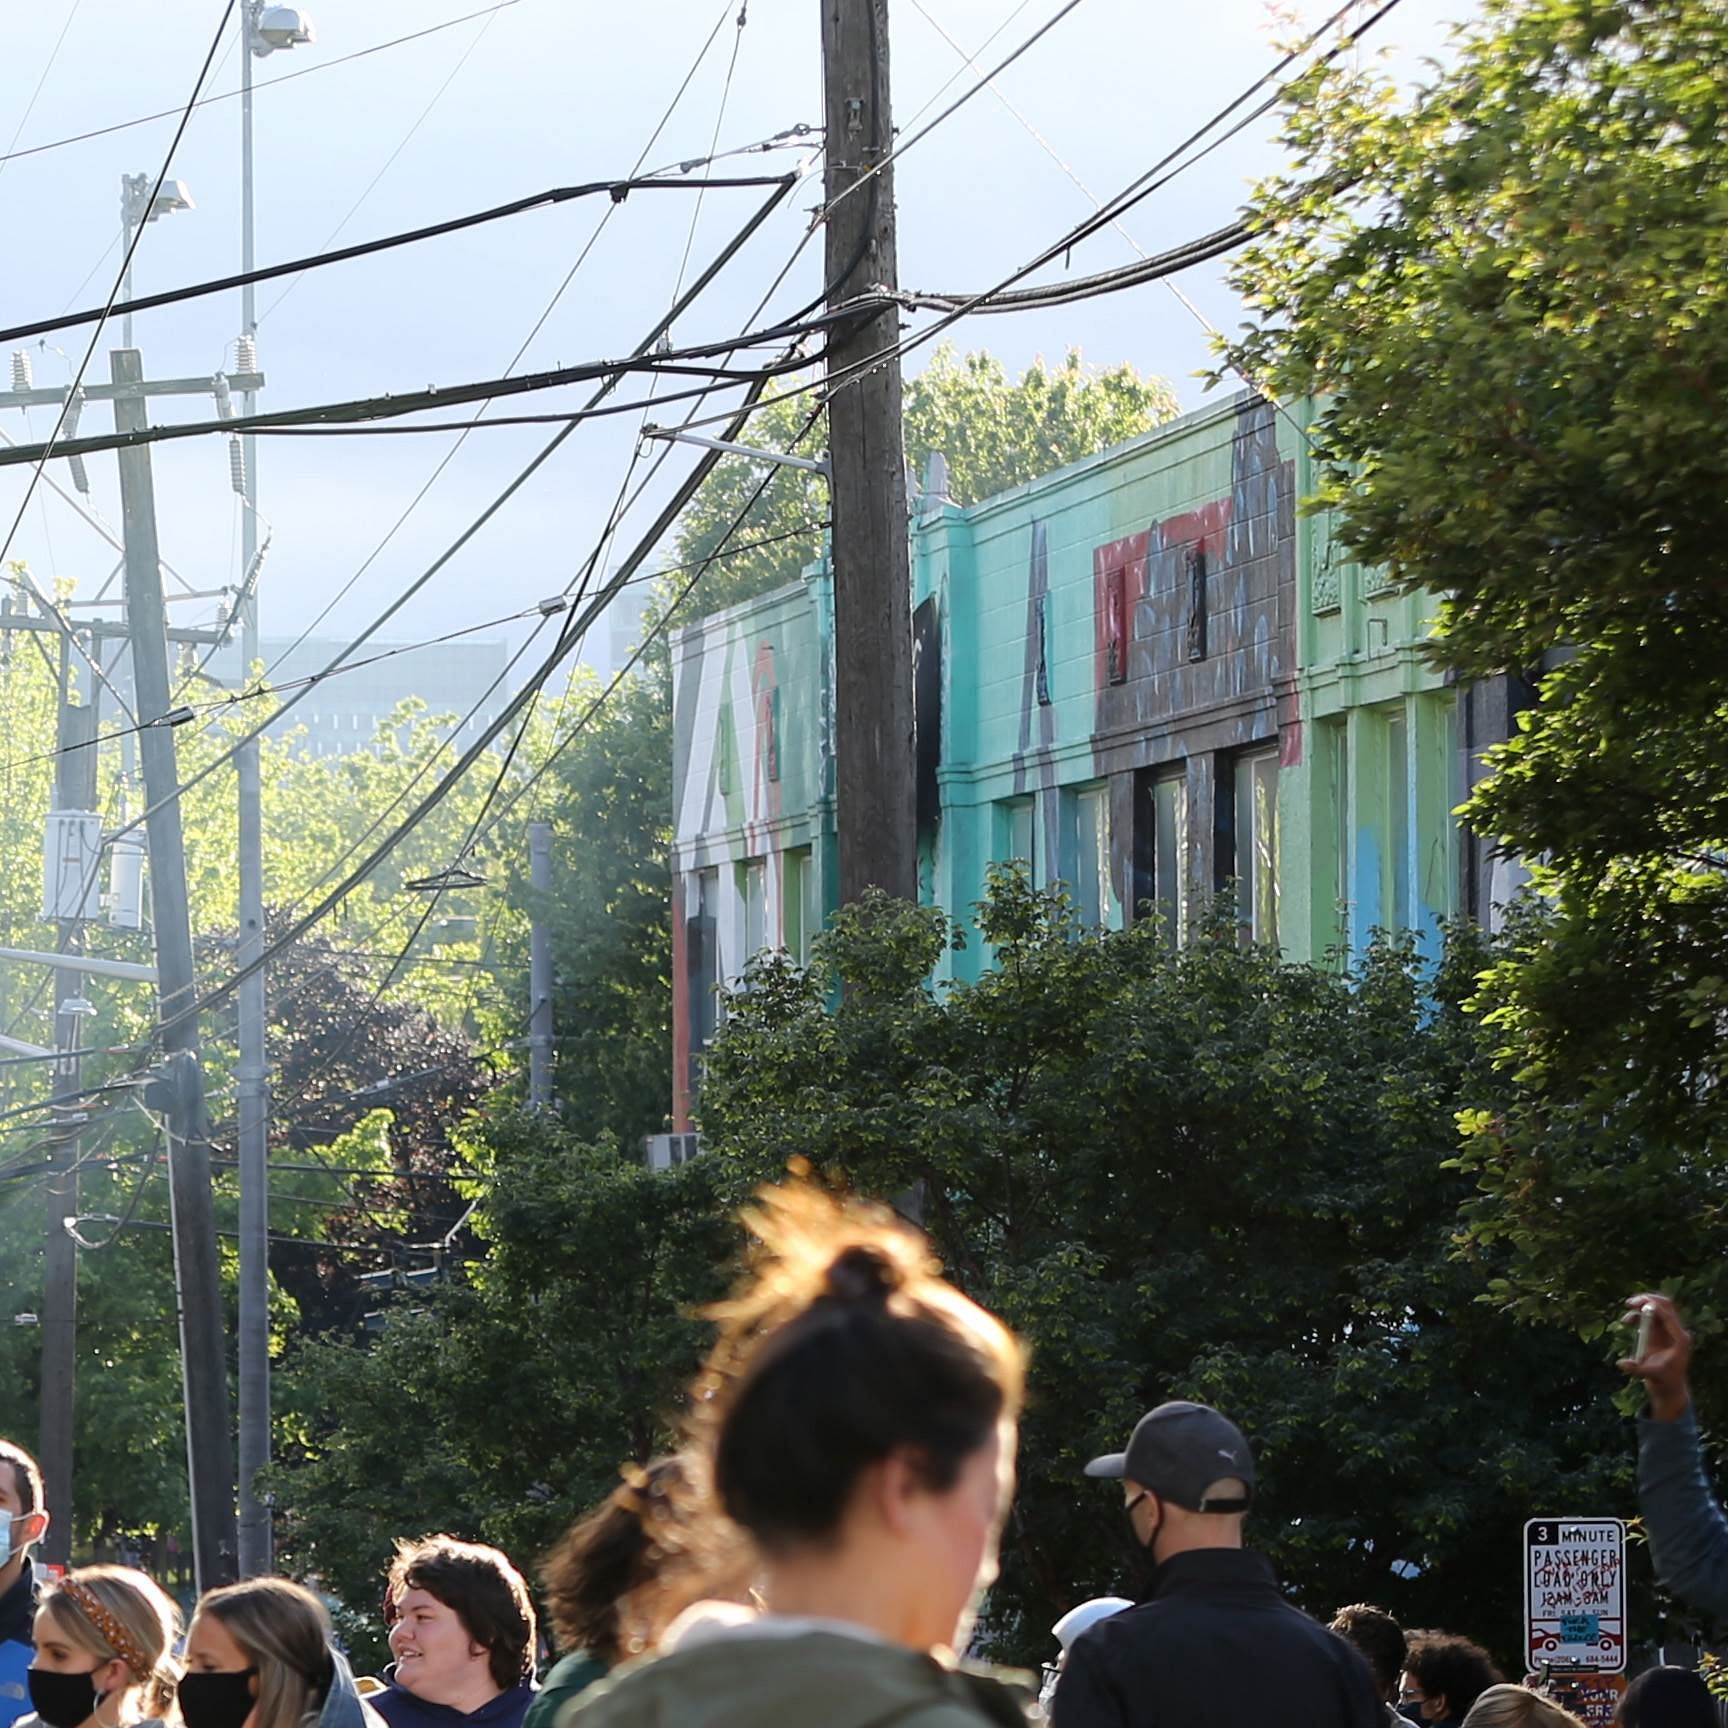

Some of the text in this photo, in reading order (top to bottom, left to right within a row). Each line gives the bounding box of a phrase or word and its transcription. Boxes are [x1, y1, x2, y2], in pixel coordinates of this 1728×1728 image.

[1537, 1526, 1614, 1542] 3 MINUTE
[1534, 1549, 1616, 1567] PASSENGER
[1534, 1570, 1616, 1588] LOAD ONLY
